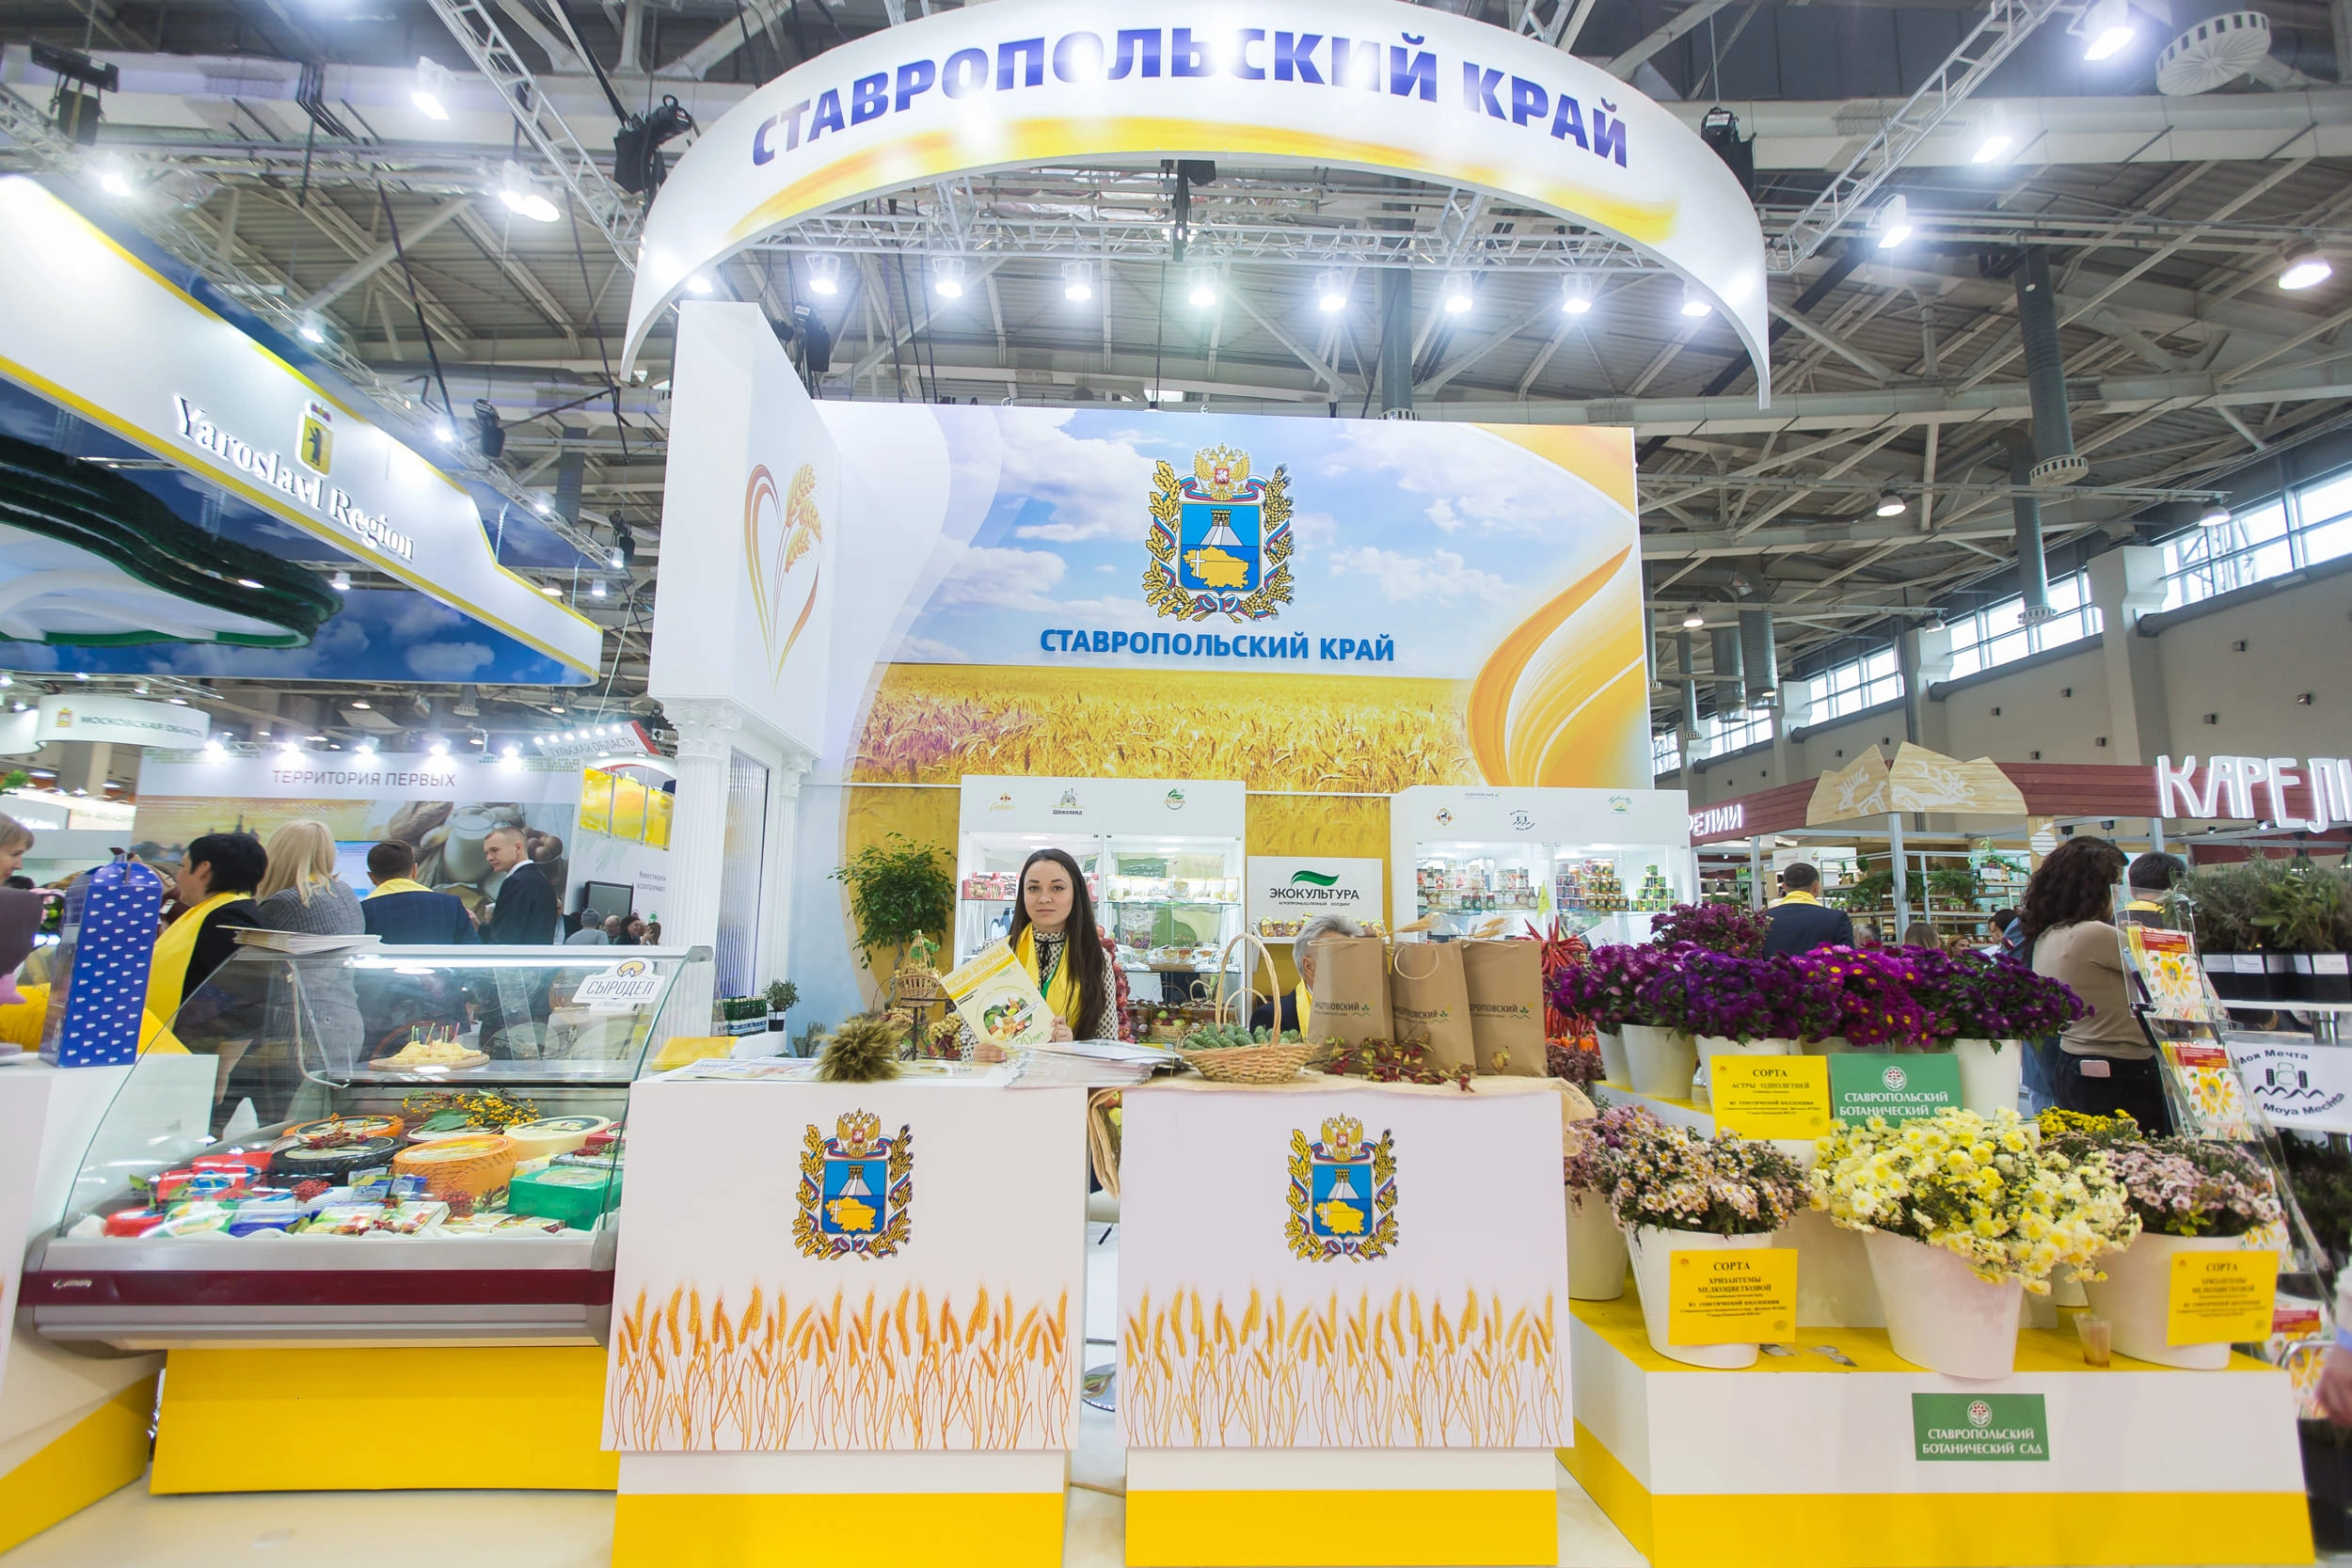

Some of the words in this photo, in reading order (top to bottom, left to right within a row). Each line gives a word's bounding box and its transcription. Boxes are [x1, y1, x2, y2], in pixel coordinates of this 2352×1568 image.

[753, 28, 1437, 166] СТАВРОПОЛЬСКИЙ
[1463, 60, 1627, 168] КРАЙ
[173, 392, 324, 512] Yaroslavl
[329, 487, 414, 563] Region
[1040, 628, 1309, 658] СТАВРОПОЛЬСКИЙ
[1320, 633, 1394, 662] КРАЙ
[272, 769, 380, 785] ТЕРРИТОРИЯ
[385, 772, 456, 787] ПЕРВЫХ
[1269, 888, 1359, 900] ЭКОКУЛЬТУРА
[586, 980, 655, 997] СЫРОДЕЛ
[2265, 1049, 2309, 1060] Мечта
[1753, 1069, 1788, 1077] СОРТА
[1844, 1091, 1948, 1102] СТАВРОПОЛЬСКИЙ
[1839, 1104, 1929, 1117] БОТАНИЧЕСКИЙ
[2263, 1102, 2299, 1117] Moya
[2302, 1092, 2345, 1116] Mechta
[1713, 1261, 1751, 1271] СОРТА
[2205, 1262, 2238, 1273] СОРТА
[1928, 1428, 2034, 1440] СТАВРОПОЛЬСКИЙ
[1922, 1442, 2014, 1454] БОТАНИЧЕСКИЙ
[2019, 1443, 2042, 1454] САД
